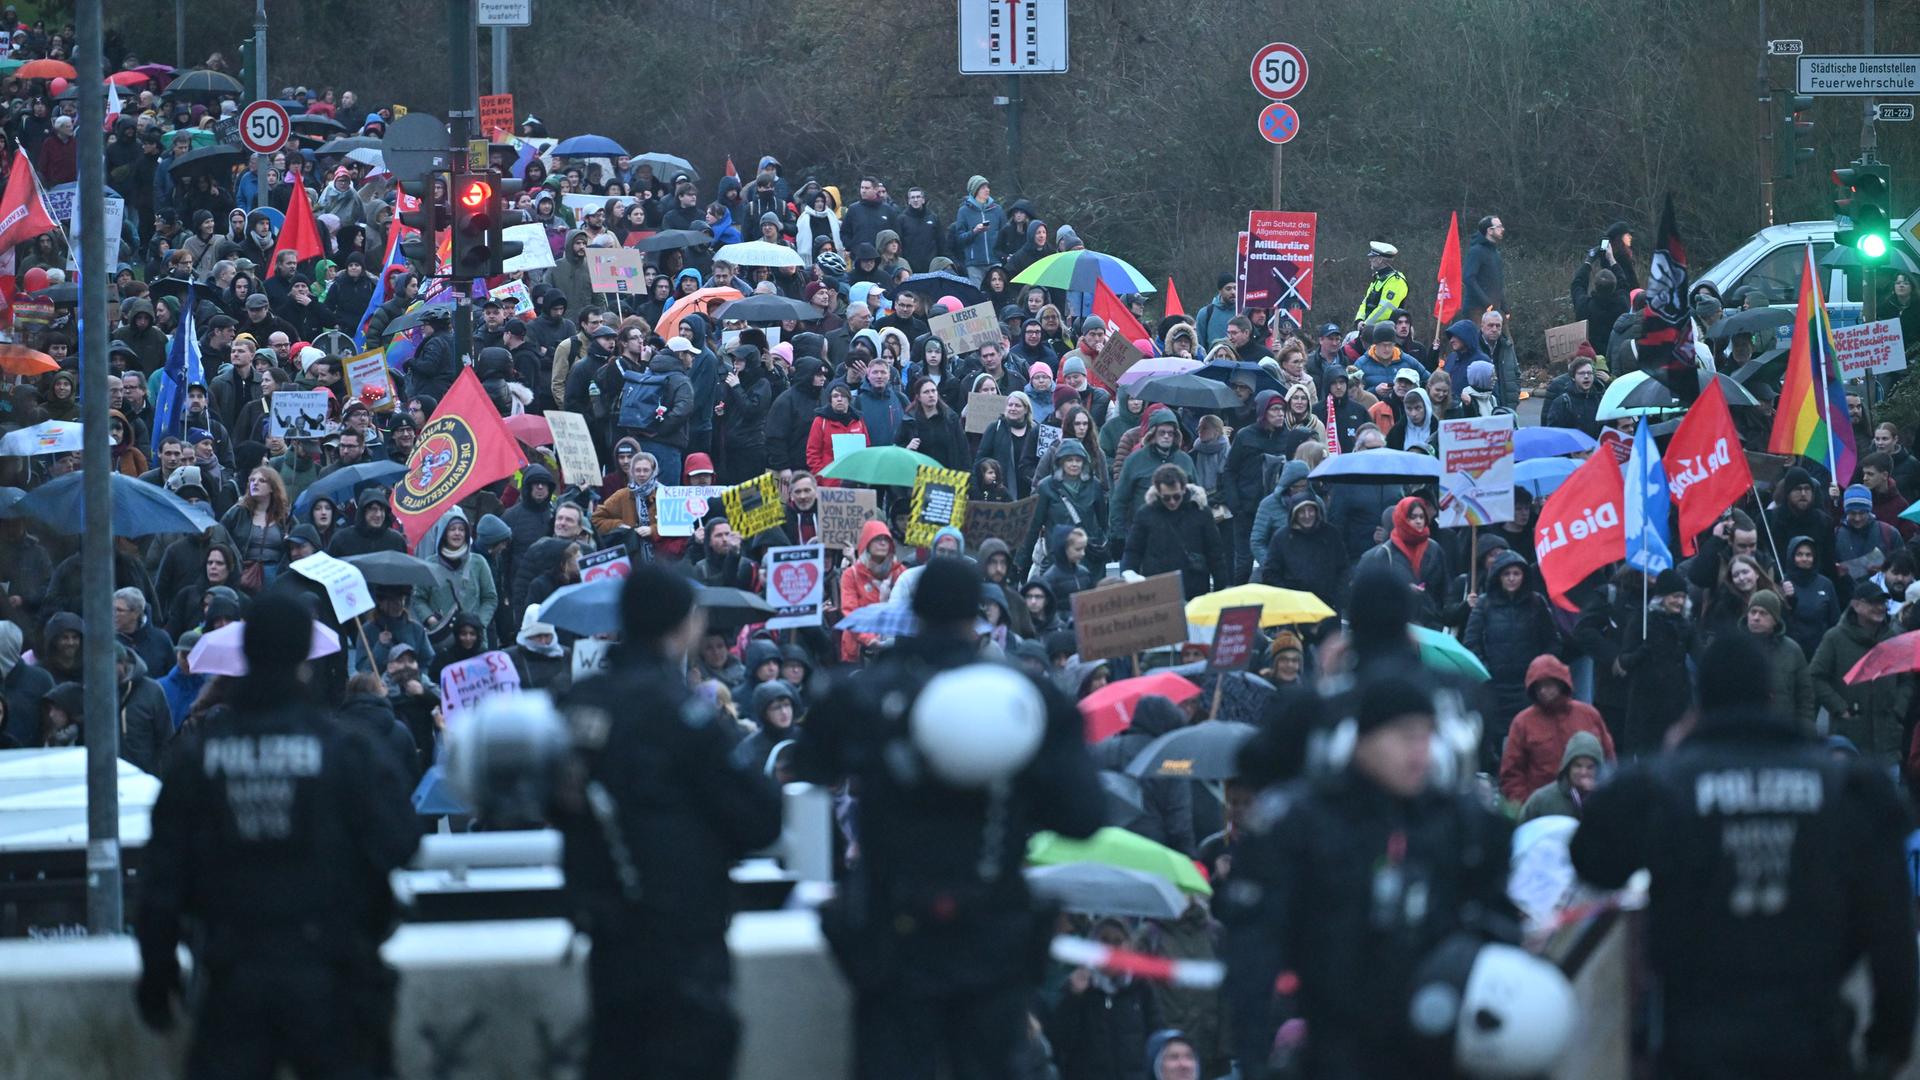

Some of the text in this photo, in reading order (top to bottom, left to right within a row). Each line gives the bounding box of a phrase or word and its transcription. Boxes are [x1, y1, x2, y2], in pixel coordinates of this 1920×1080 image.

[480, 2, 526, 10] Feuerwehr-
[488, 11, 520, 20] ausfahrt
[1776, 43, 1799, 52] 245-255
[1265, 59, 1296, 84] 50
[1810, 62, 1916, 73] Städtische Dienststellen
[1811, 77, 1914, 88] Feuerwehrschule
[1883, 109, 1909, 117] 221-229
[252, 115, 280, 139] 50
[1273, 220, 1296, 228] Schutz
[1298, 221, 1311, 229] des
[1256, 228, 1312, 237] Allgemeinwohls:
[1254, 240, 1310, 250] Milliardäre
[1250, 252, 1313, 262] entmachten!
[951, 308, 978, 323] LIEBER
[1846, 325, 1870, 338] sind
[1872, 323, 1889, 335] die
[1873, 345, 1891, 355] sie
[1842, 352, 1890, 372] braucht?
[821, 490, 856, 504] NAZIS
[822, 504, 864, 517] VON DER
[822, 530, 858, 545] FEGEN
[780, 551, 811, 561] FCK
